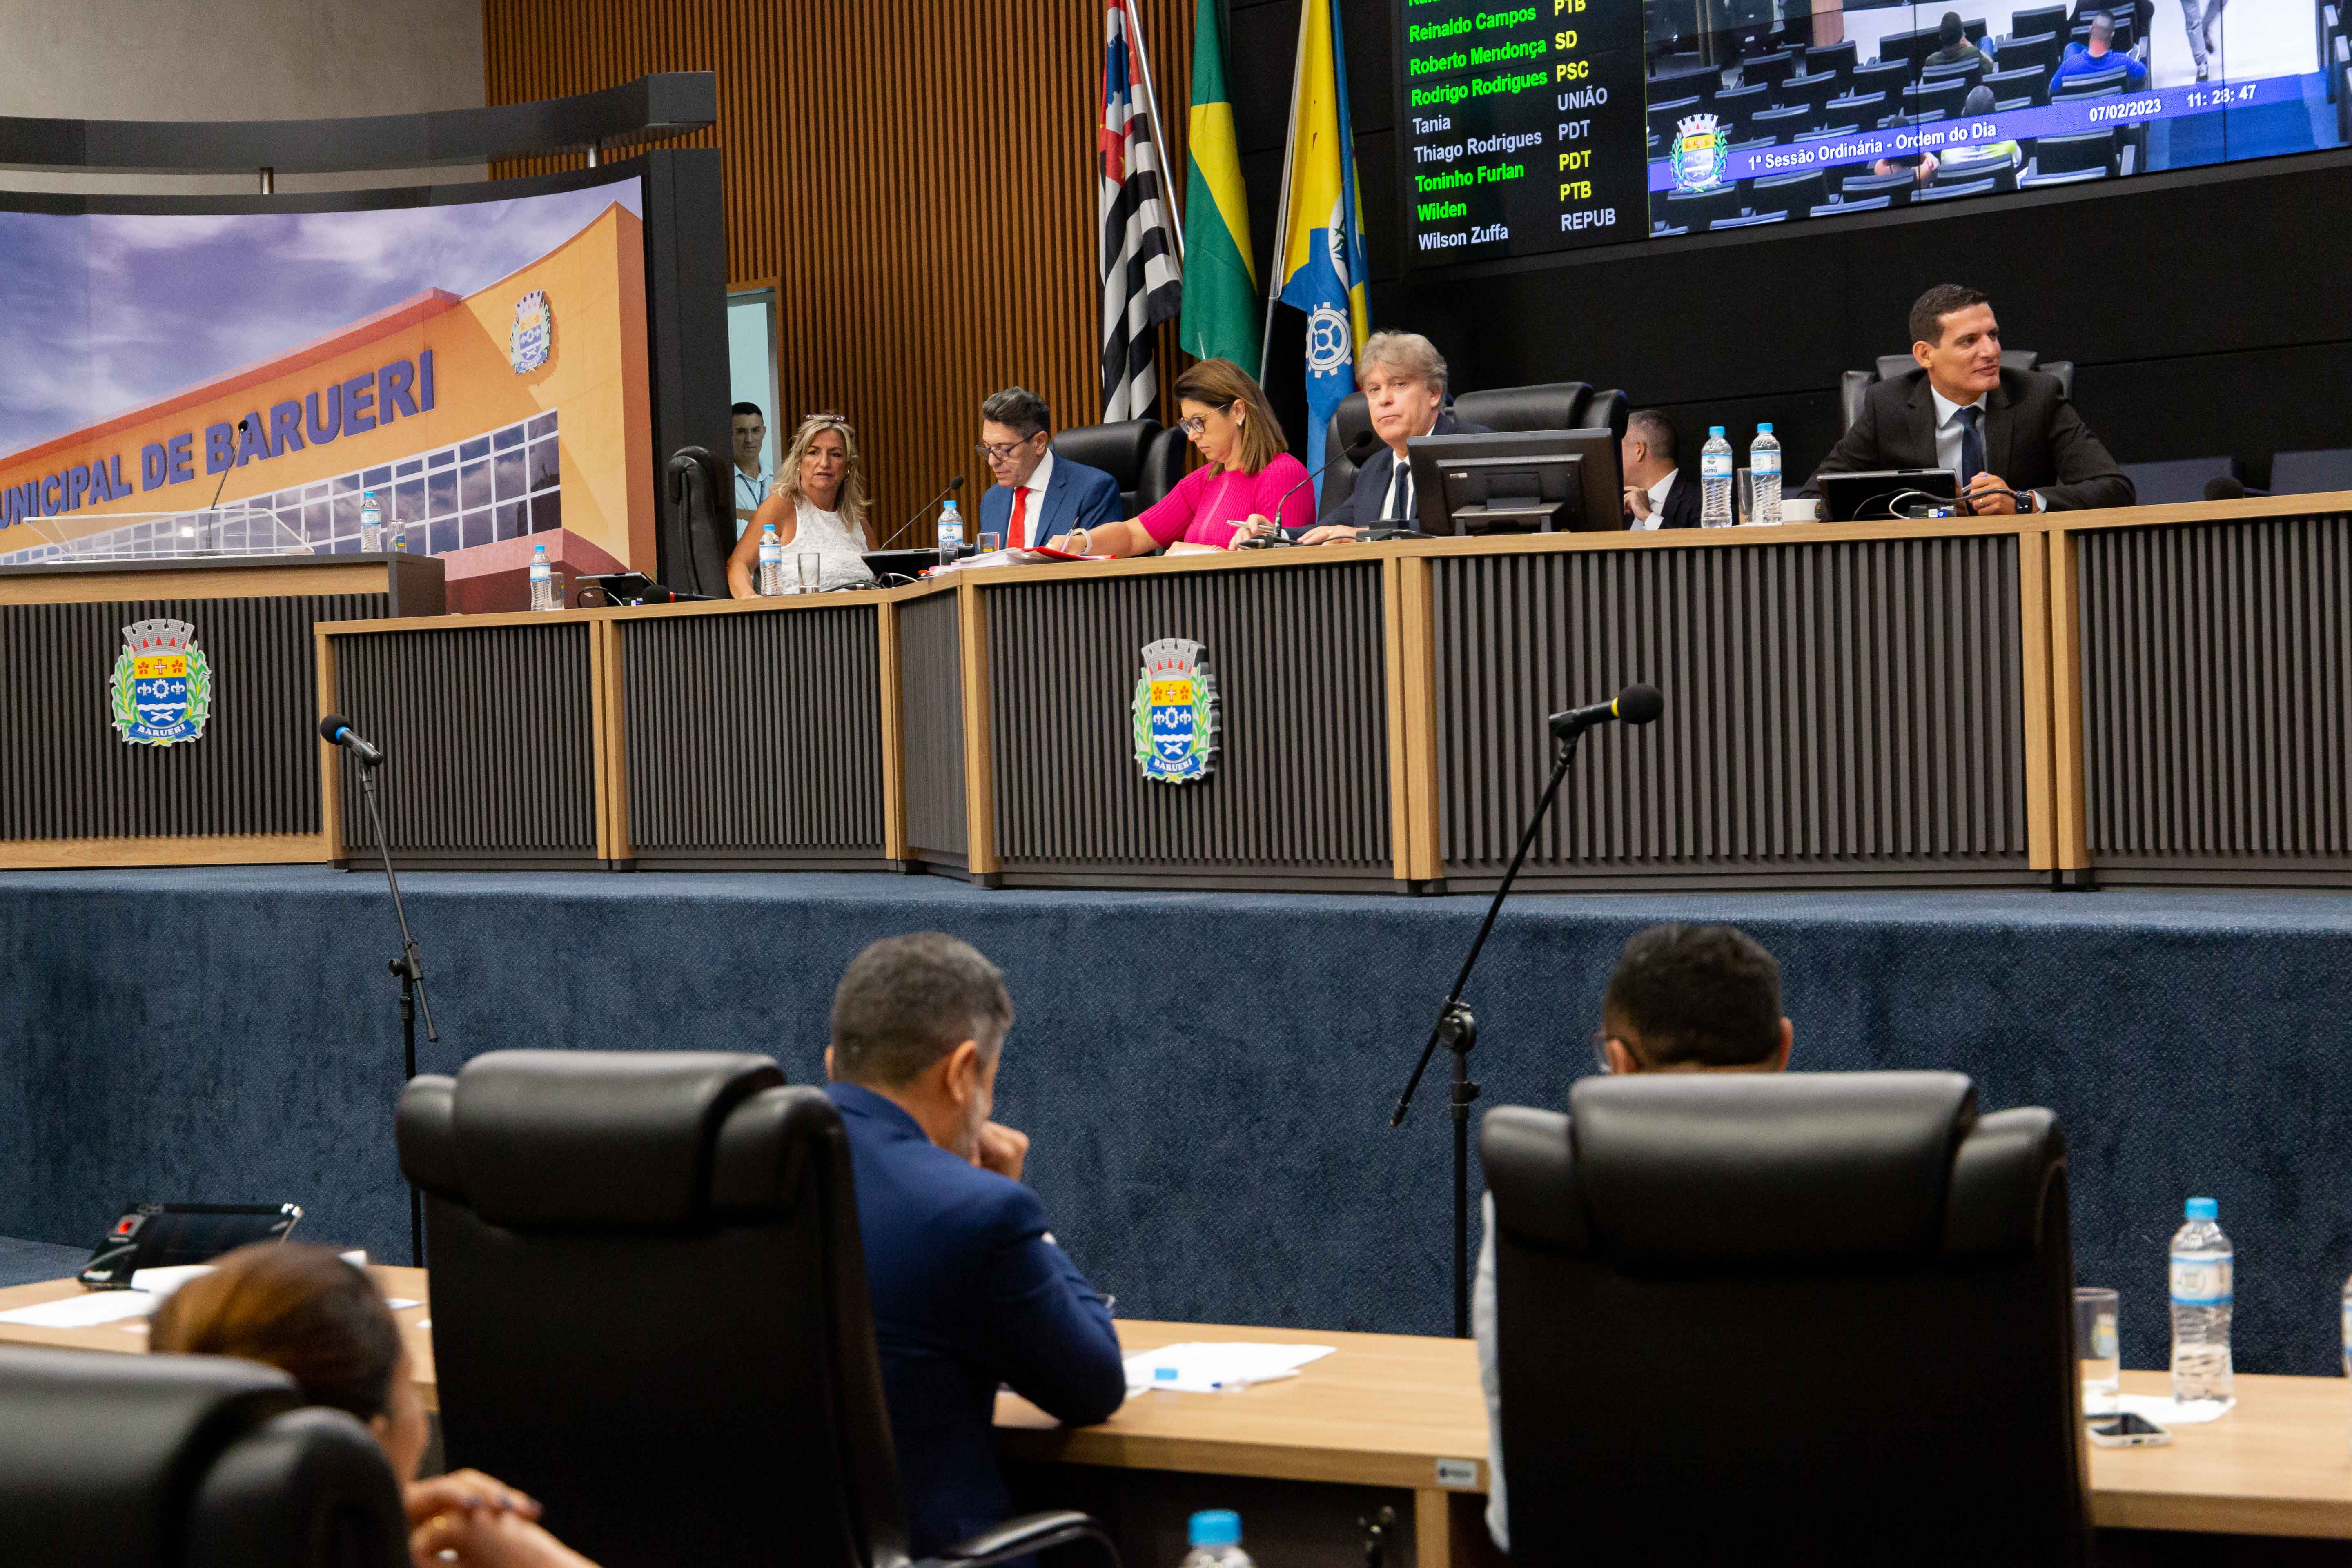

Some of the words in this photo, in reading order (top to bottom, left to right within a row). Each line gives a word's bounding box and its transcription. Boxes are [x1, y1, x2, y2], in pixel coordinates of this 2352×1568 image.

[1410, 17, 1472, 42] Reinaldo
[1476, 7, 1537, 29] Campos
[1554, 0, 1586, 16] PTB
[1410, 52, 1467, 76] Roberto
[1471, 40, 1546, 65] Mendonça
[1555, 30, 1577, 49] SD
[1412, 84, 1468, 107] Rodrigo
[1472, 71, 1548, 96] Rodrigues
[1557, 61, 1589, 82] PSC
[2089, 98, 2162, 122] 07/02/2023
[2187, 92, 2207, 107] 11:
[2239, 84, 2256, 100] 47
[1412, 114, 1451, 134] Tania
[1558, 85, 1608, 111] UNIÃO
[1414, 144, 1463, 163] Thiago
[1467, 132, 1542, 155] Rodrigues
[1559, 120, 1590, 140] PDT
[1749, 155, 1762, 171] 1ª
[1765, 149, 1815, 168] Sessão
[1818, 138, 1883, 160] Ordinária
[1895, 131, 1945, 149] Ordem
[1949, 126, 1968, 142] do
[1972, 122, 1996, 138] Dia
[1415, 170, 1473, 192] Toninho
[1477, 163, 1524, 183] Furlan
[1559, 150, 1591, 171] PDT
[1417, 201, 1466, 221] Wilden
[1560, 180, 1592, 201] PTB
[1418, 232, 1467, 250] Wilson
[1471, 224, 1509, 243] Zuffa
[1561, 207, 1616, 231] REPUB
[141, 432, 194, 492] DE
[205, 348, 435, 476] BARUERI
[138, 724, 186, 736] BARUERI
[1154, 757, 1193, 772] BARUERI
